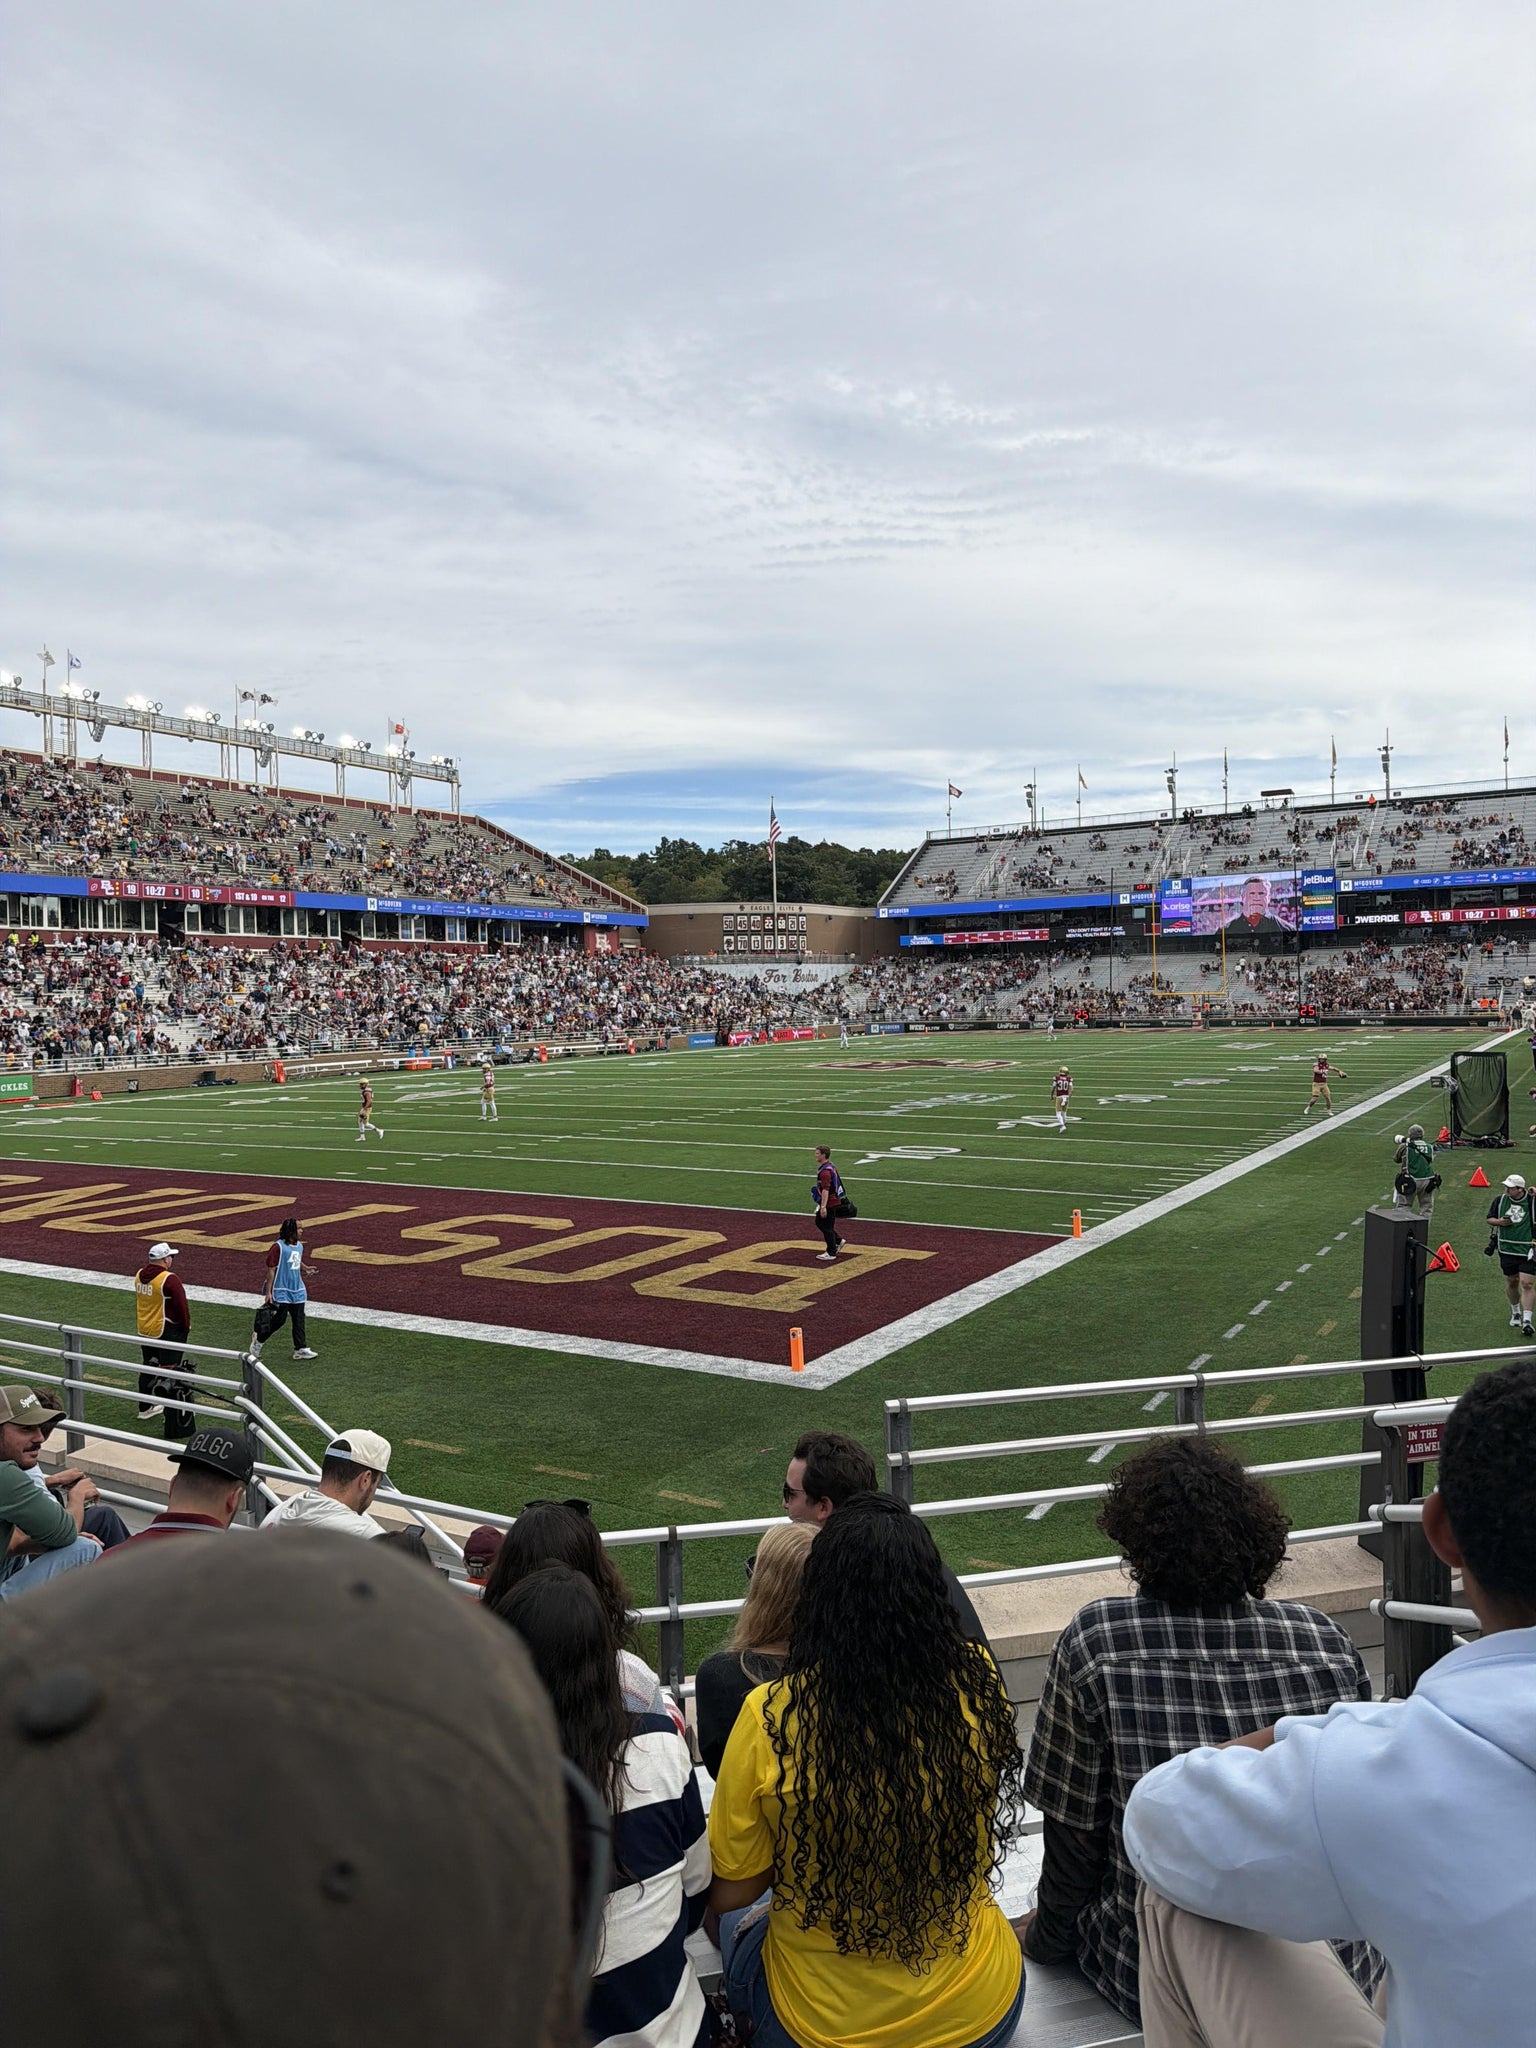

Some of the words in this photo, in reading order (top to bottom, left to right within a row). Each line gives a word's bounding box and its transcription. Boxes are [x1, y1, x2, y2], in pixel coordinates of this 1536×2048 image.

[1303, 874, 1334, 886] jetBlue
[126, 884, 136, 895] 19
[145, 886, 166, 896] 10:27
[1441, 912, 1451, 921] 19
[1465, 911, 1484, 919] 10:27
[1508, 909, 1519, 918] 10
[763, 968, 787, 983] For
[792, 968, 819, 983] Boston
[1075, 1010, 1089, 1020] 25
[1300, 1005, 1315, 1015] 25
[1057, 1080, 1069, 1091] 30
[0, 1183, 937, 1313] BOSTON
[1408, 1430, 1418, 1441] IN
[1420, 1428, 1438, 1440] THE
[190, 1433, 234, 1460] GLGC
[1406, 1441, 1441, 1454] AIRWE
